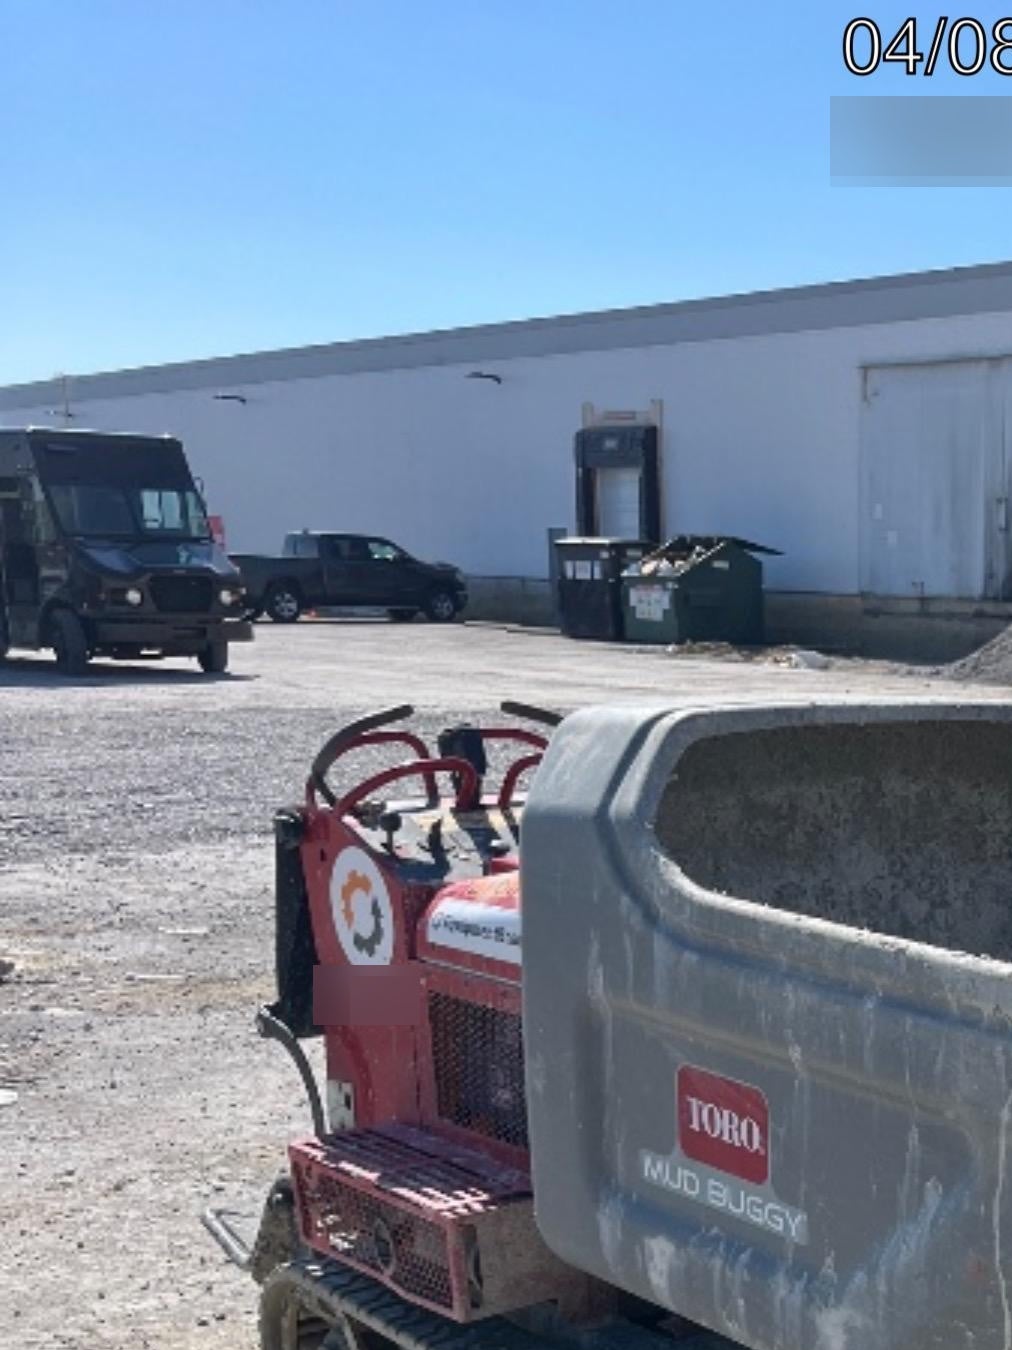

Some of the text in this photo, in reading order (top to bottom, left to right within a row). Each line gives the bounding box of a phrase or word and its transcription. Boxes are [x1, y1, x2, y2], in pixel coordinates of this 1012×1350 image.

[685, 1096, 764, 1154] TORO
[643, 1155, 803, 1237] MUD BUGGY
